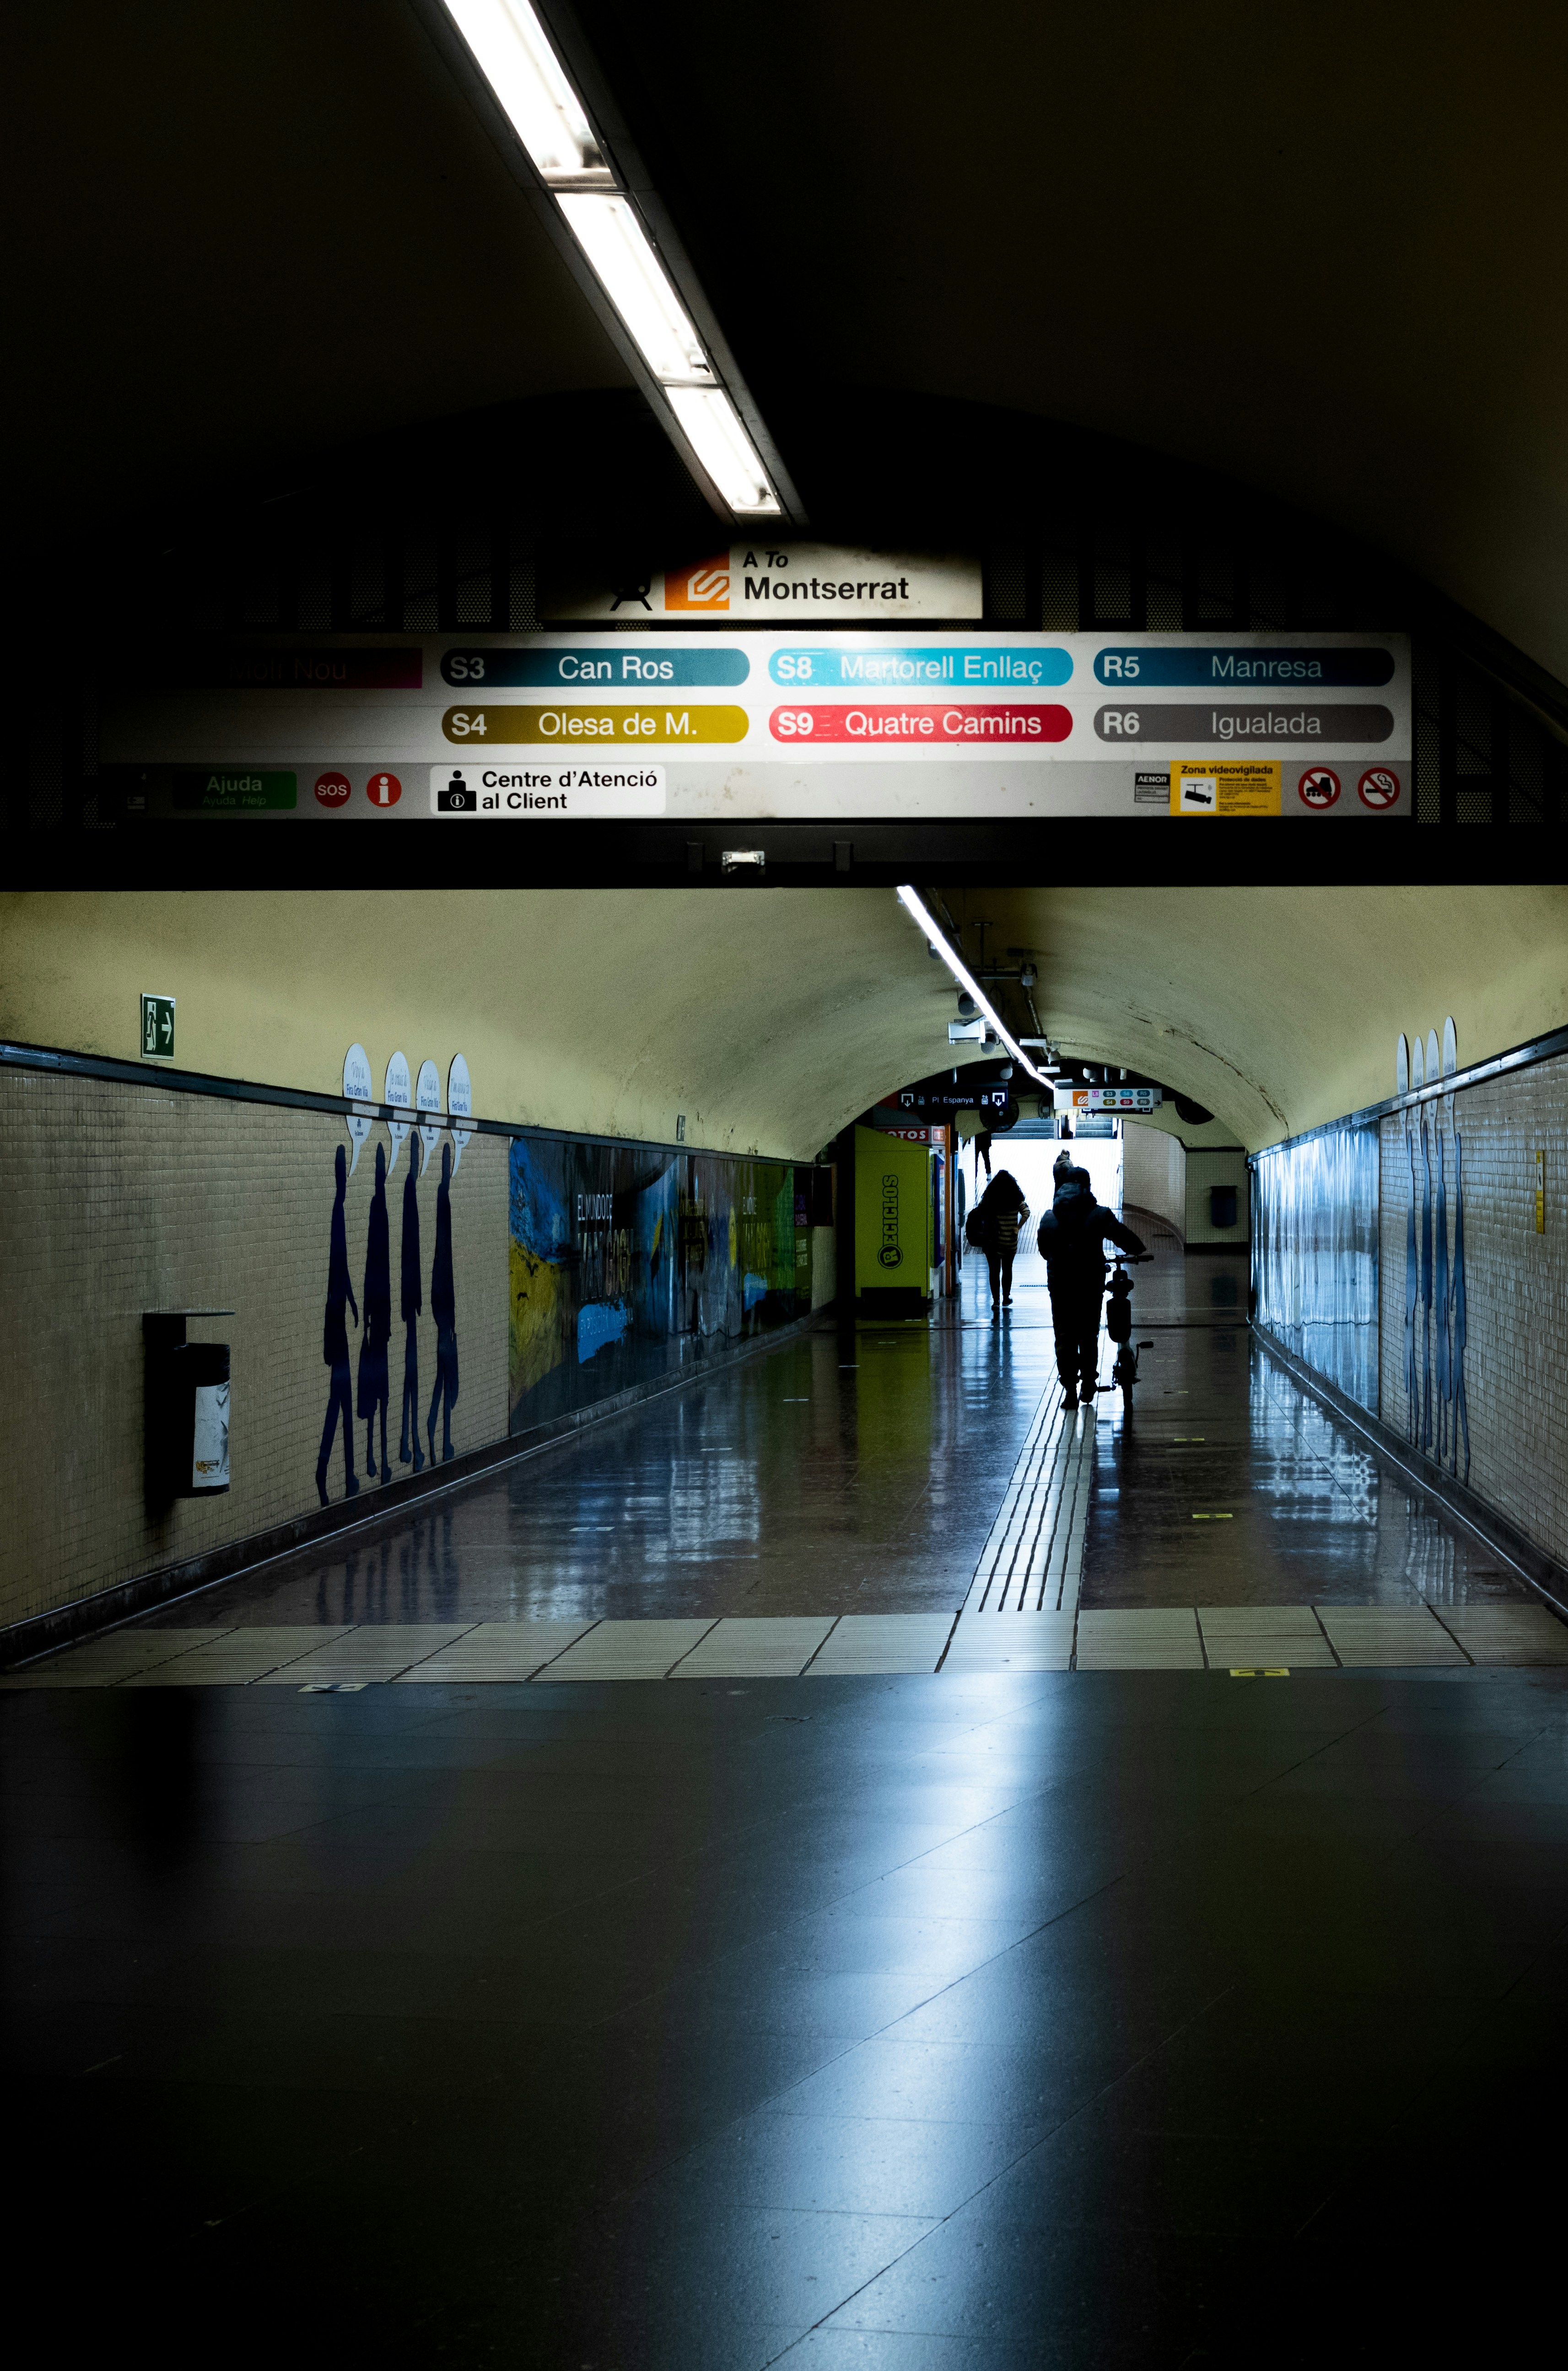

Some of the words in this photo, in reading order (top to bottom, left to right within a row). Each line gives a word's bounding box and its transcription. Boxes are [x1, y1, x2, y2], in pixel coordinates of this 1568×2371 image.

[743, 551, 758, 568] A
[765, 551, 789, 568] To
[744, 577, 909, 601] Montserrat
[228, 657, 285, 680] Molí
[294, 659, 347, 681] Nou
[450, 656, 485, 680] S3
[558, 656, 612, 680] Can
[622, 656, 674, 680] Ros
[777, 656, 813, 680] S8
[841, 655, 954, 679] Martorell
[964, 655, 1043, 685] Enllaç
[1104, 656, 1140, 679] R5
[1212, 655, 1322, 679] Manresa
[451, 713, 487, 737] S4
[539, 712, 614, 736] Olesa
[623, 712, 656, 736] de
[665, 712, 698, 736] M.
[777, 712, 814, 736] S9
[845, 711, 934, 736] Quatre
[943, 711, 1042, 735] Camins
[1104, 712, 1140, 735] R6
[1212, 711, 1322, 740] Igualada
[482, 771, 551, 787] Centre
[559, 770, 657, 787] d'Atenció
[1181, 765, 1206, 774] Zona
[1209, 765, 1273, 776] videovigilada
[206, 776, 263, 794] Ajuda
[202, 796, 236, 808] Ayuda
[242, 796, 267, 807] Help
[482, 793, 499, 809] al
[507, 793, 567, 809] Client
[577, 1194, 585, 1221] EL
[586, 1193, 606, 1220] MUNDO
[606, 1193, 613, 1220] DE
[878, 1175, 904, 1270] RECICLOS
